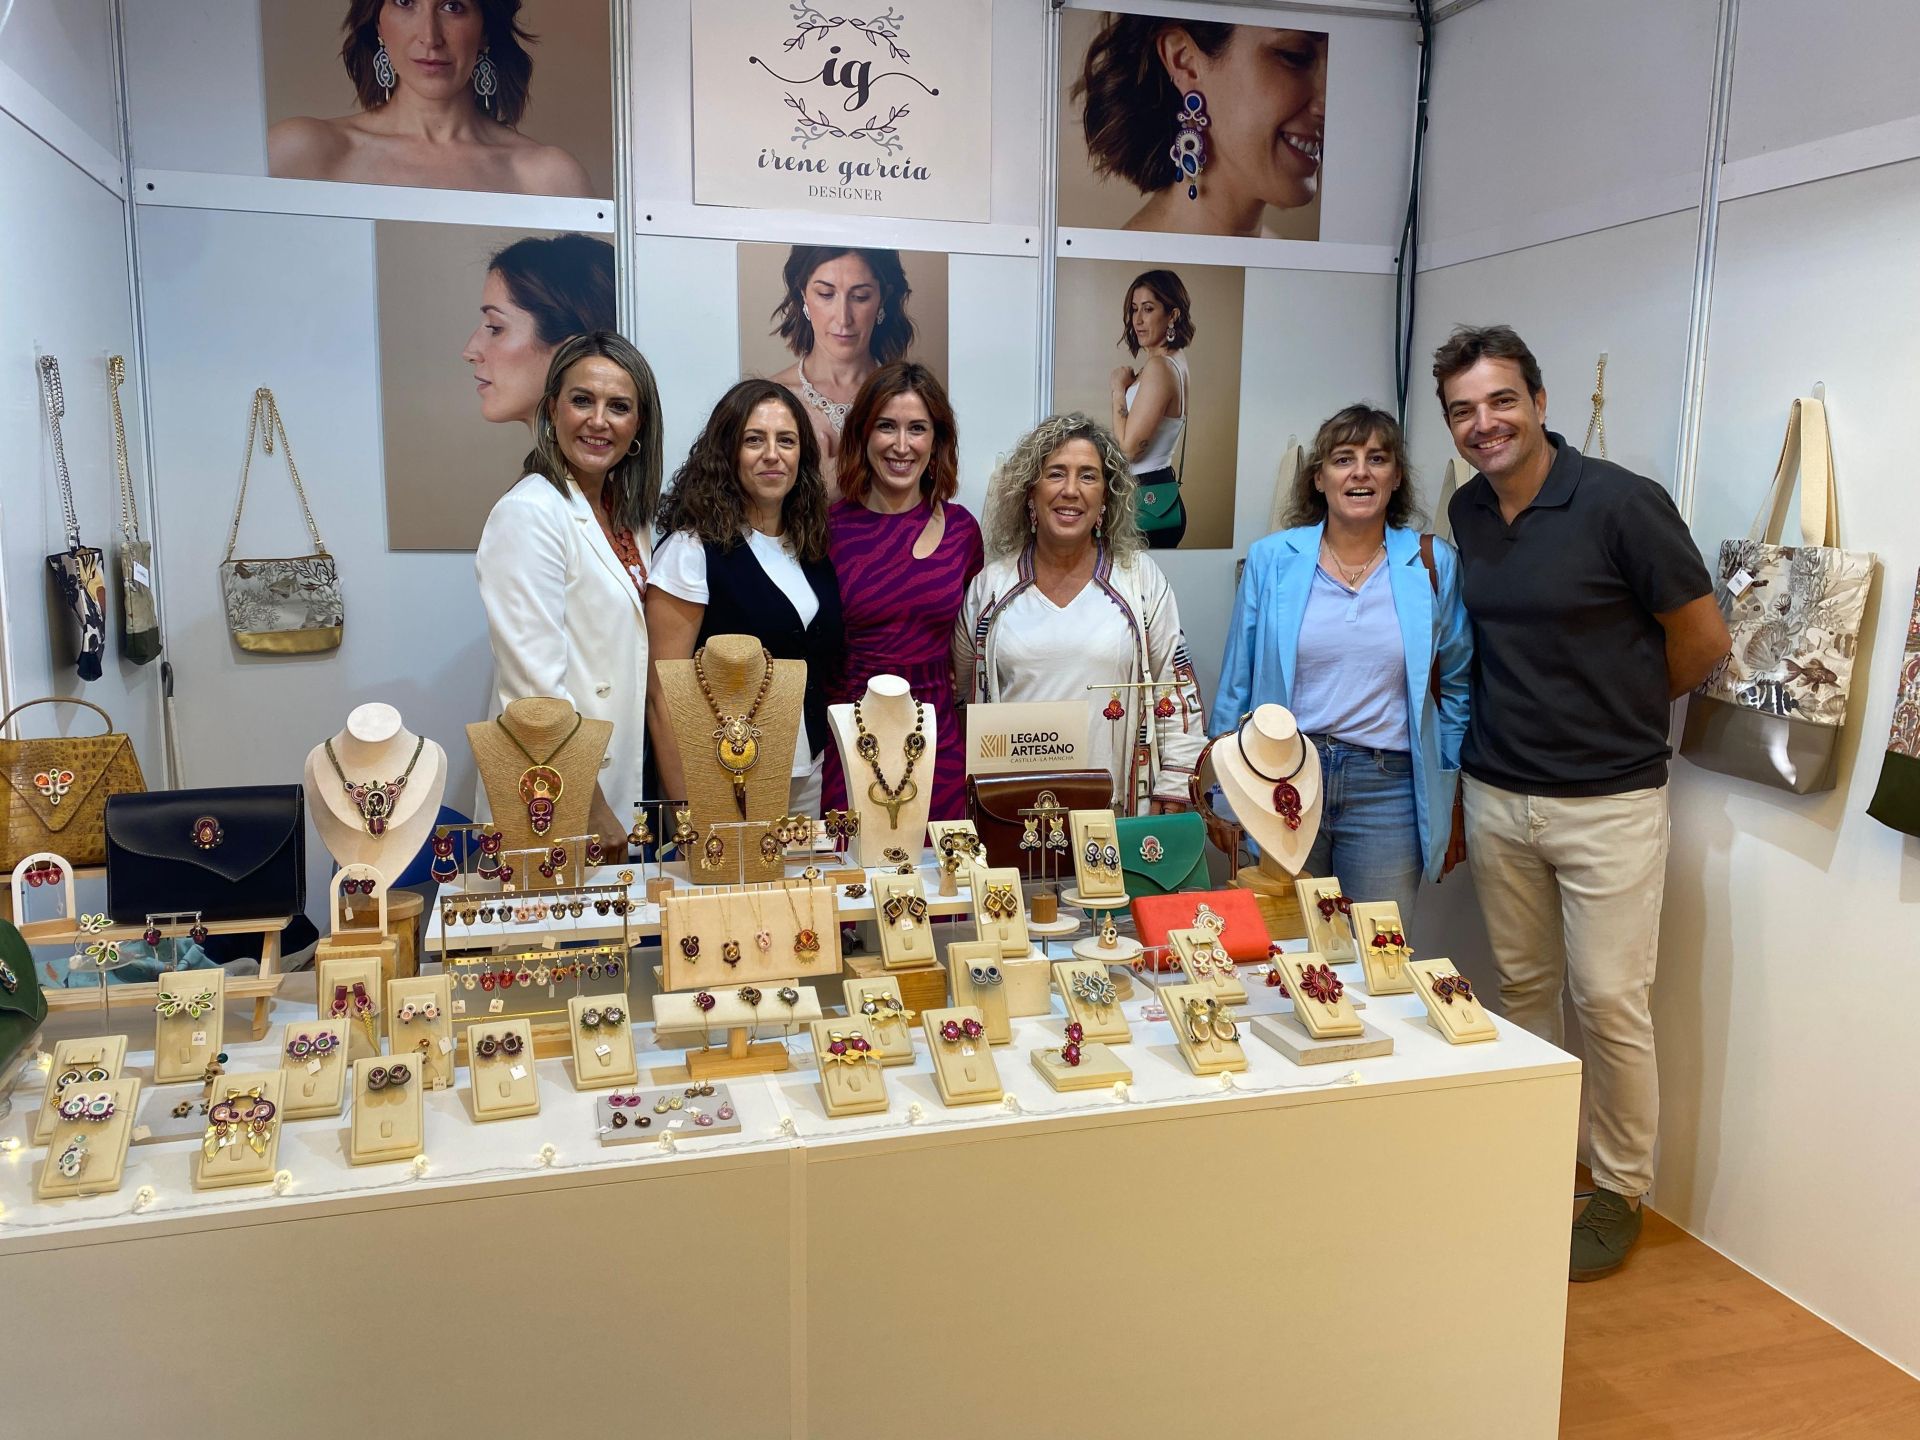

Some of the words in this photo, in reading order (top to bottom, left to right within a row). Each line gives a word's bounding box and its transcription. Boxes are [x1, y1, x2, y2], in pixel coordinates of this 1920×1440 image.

[758, 148, 830, 173] irene
[808, 184, 883, 202] DESIGNER
[1011, 732, 1058, 744] LEGADO
[1011, 744, 1074, 756] ARTESANO
